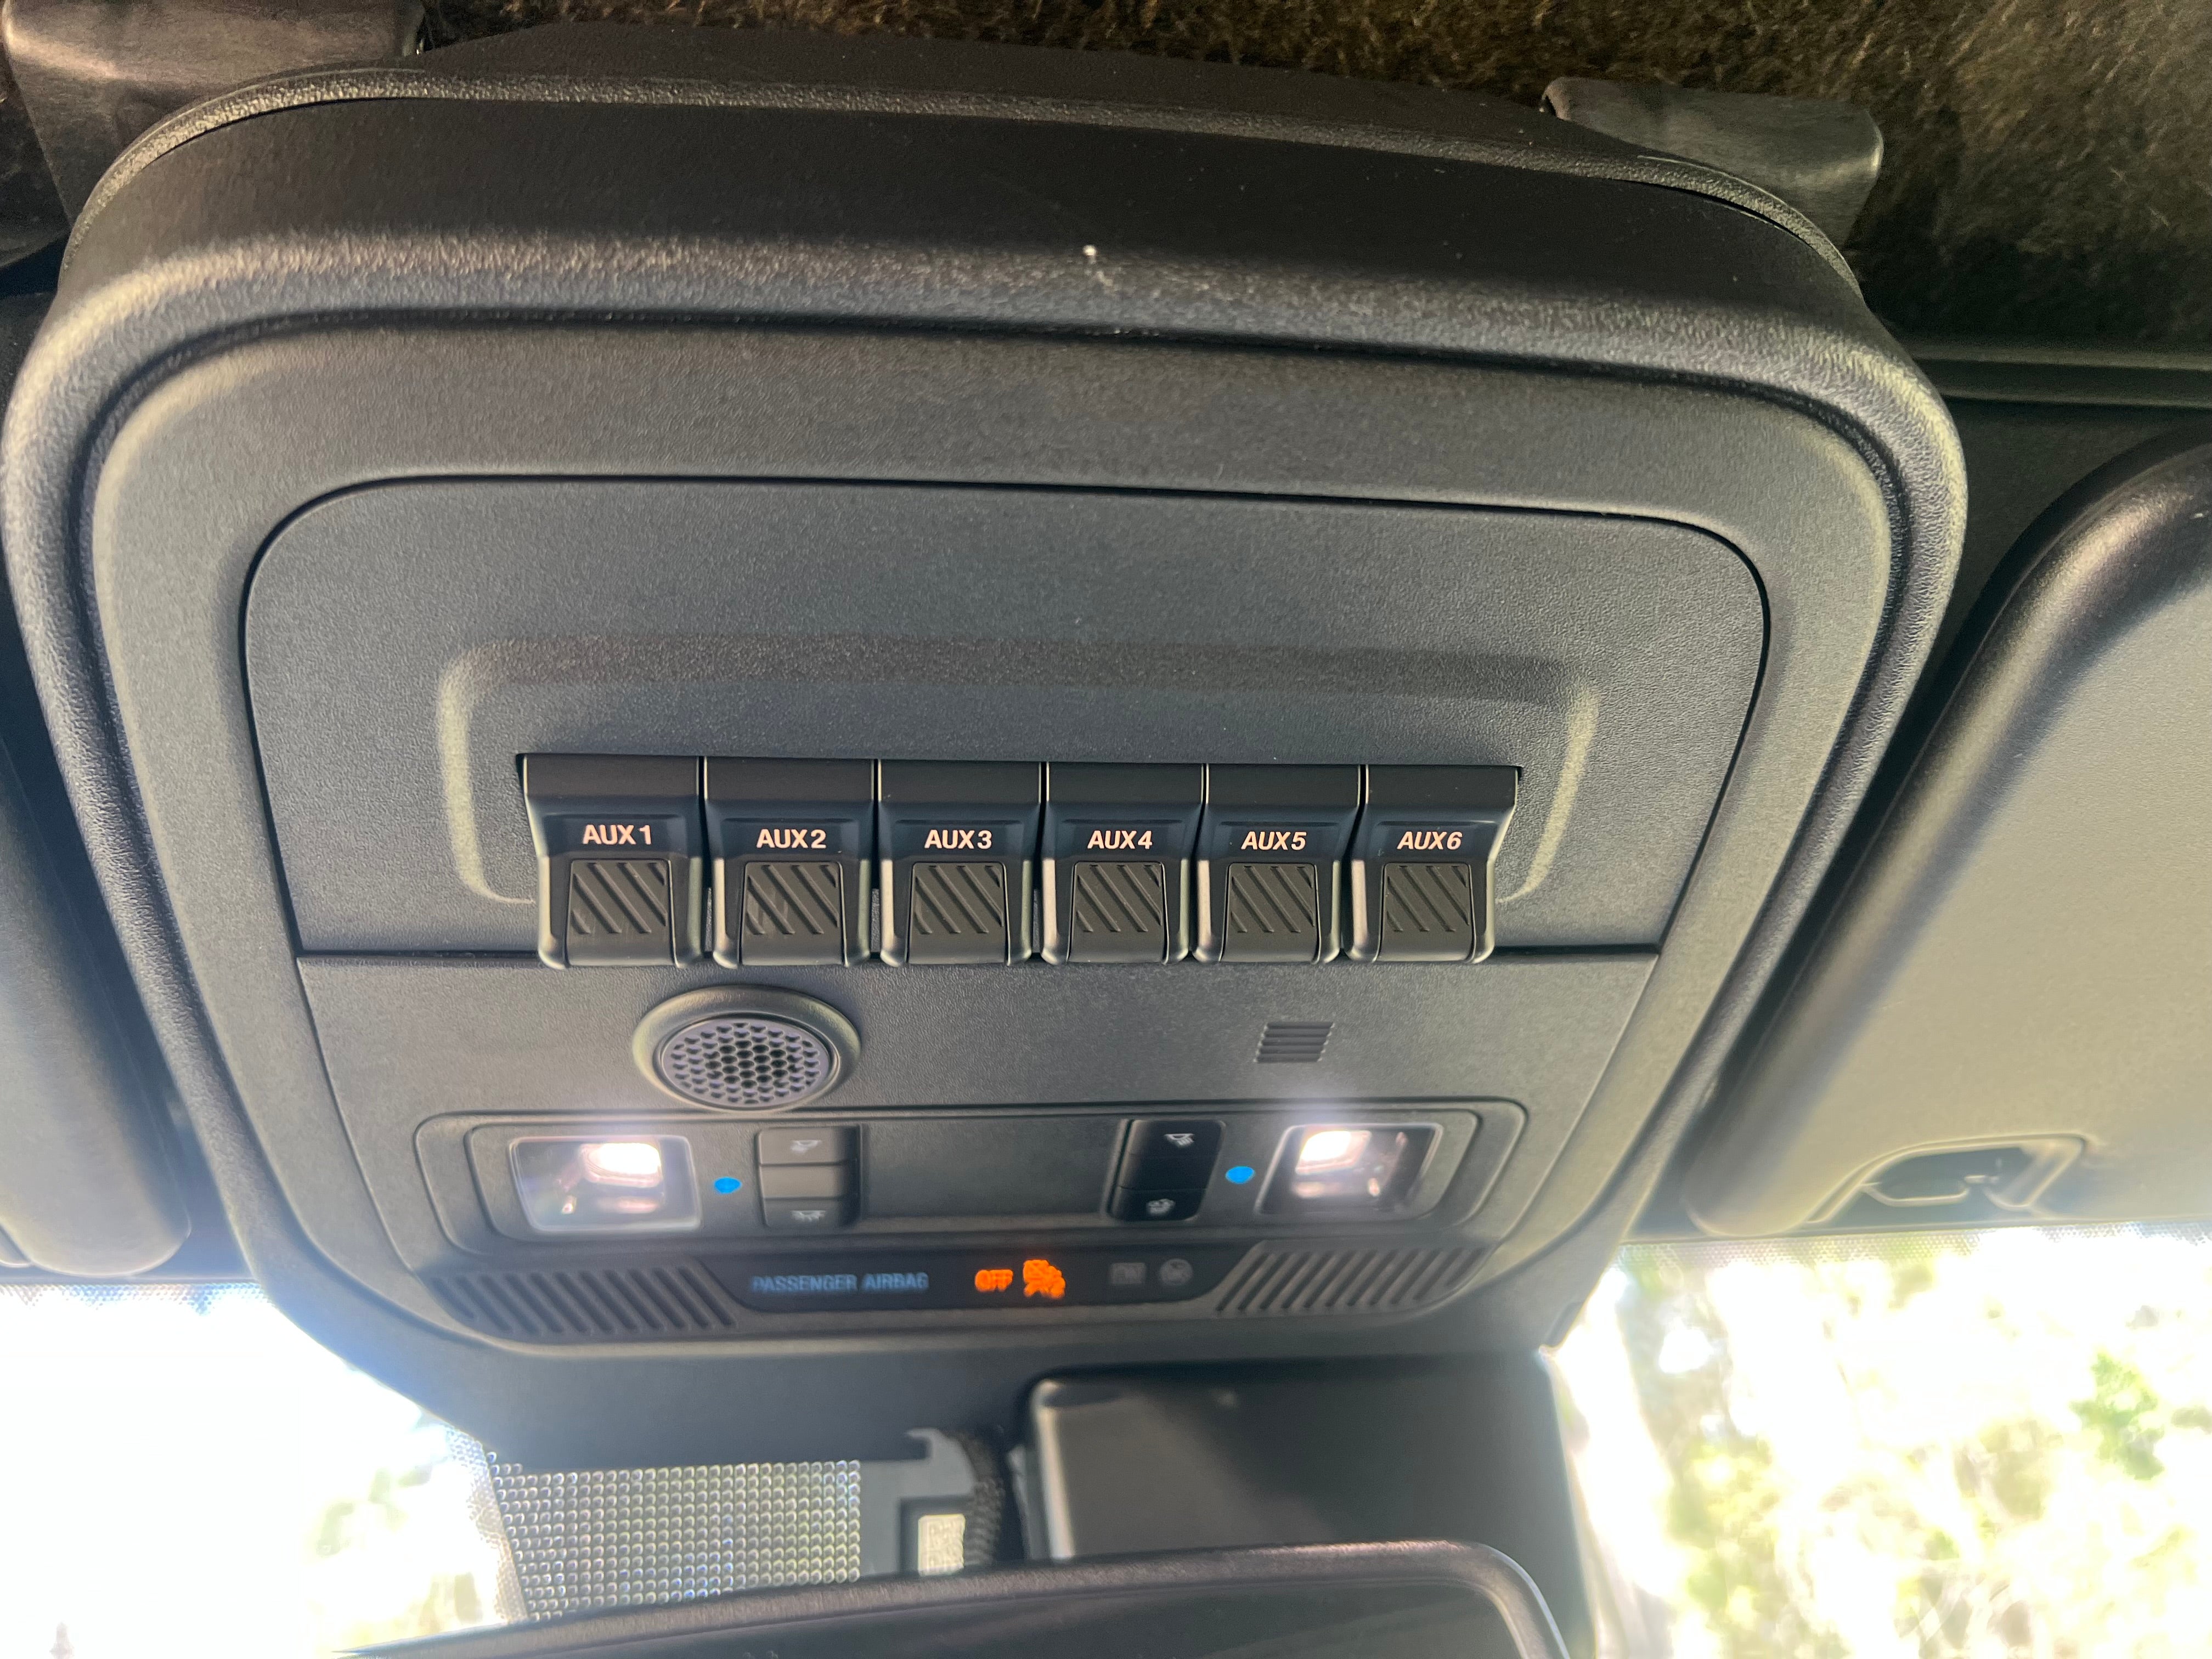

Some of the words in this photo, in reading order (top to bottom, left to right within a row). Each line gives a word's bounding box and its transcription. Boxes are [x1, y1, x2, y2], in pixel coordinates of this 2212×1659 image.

[582, 824, 652, 845] AUX1
[756, 828, 827, 849] AUX2
[924, 829, 992, 849] AUX3
[1087, 830, 1153, 849] AUX4
[1240, 831, 1307, 850] AUX5
[1397, 831, 1463, 850] AUX6
[751, 1274, 856, 1293] PASSENGER
[860, 1272, 929, 1290] AIRBAG
[975, 1269, 1013, 1292] OFF
